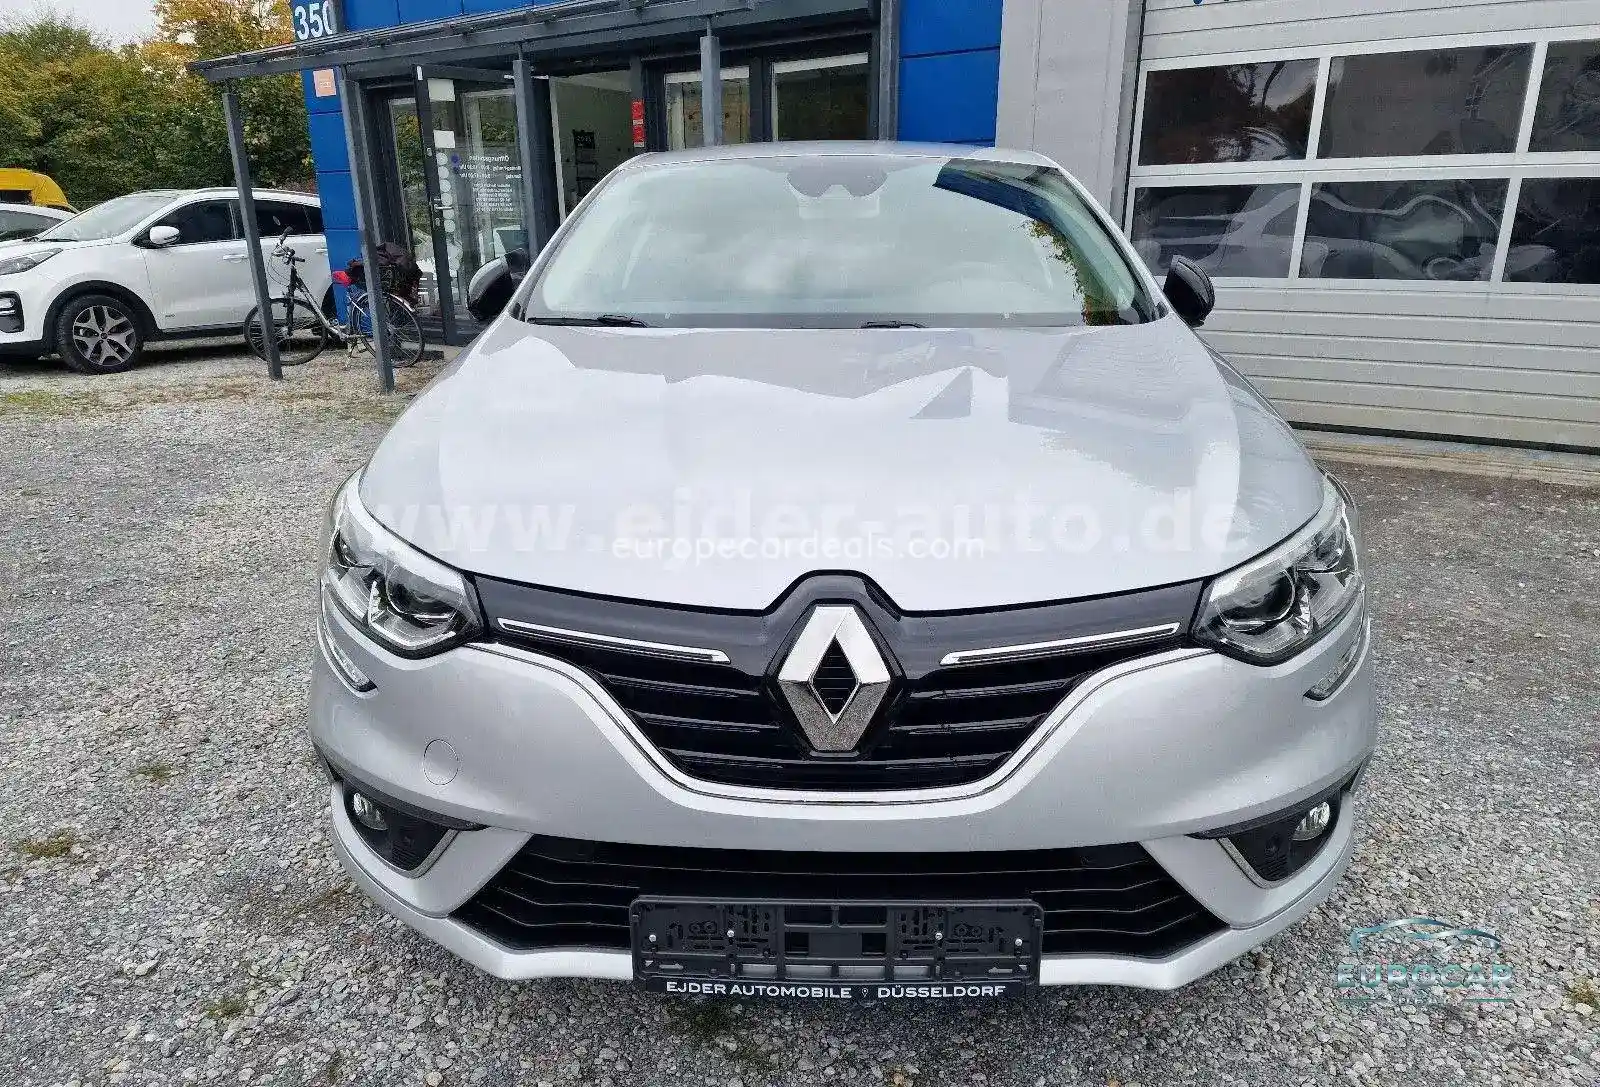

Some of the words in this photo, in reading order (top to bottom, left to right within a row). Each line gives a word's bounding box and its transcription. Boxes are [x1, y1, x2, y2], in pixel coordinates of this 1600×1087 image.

[666, 981, 726, 994] EJDER
[729, 984, 852, 998] AUTOMOBILE
[877, 985, 1006, 998] DÜSSELDORF
